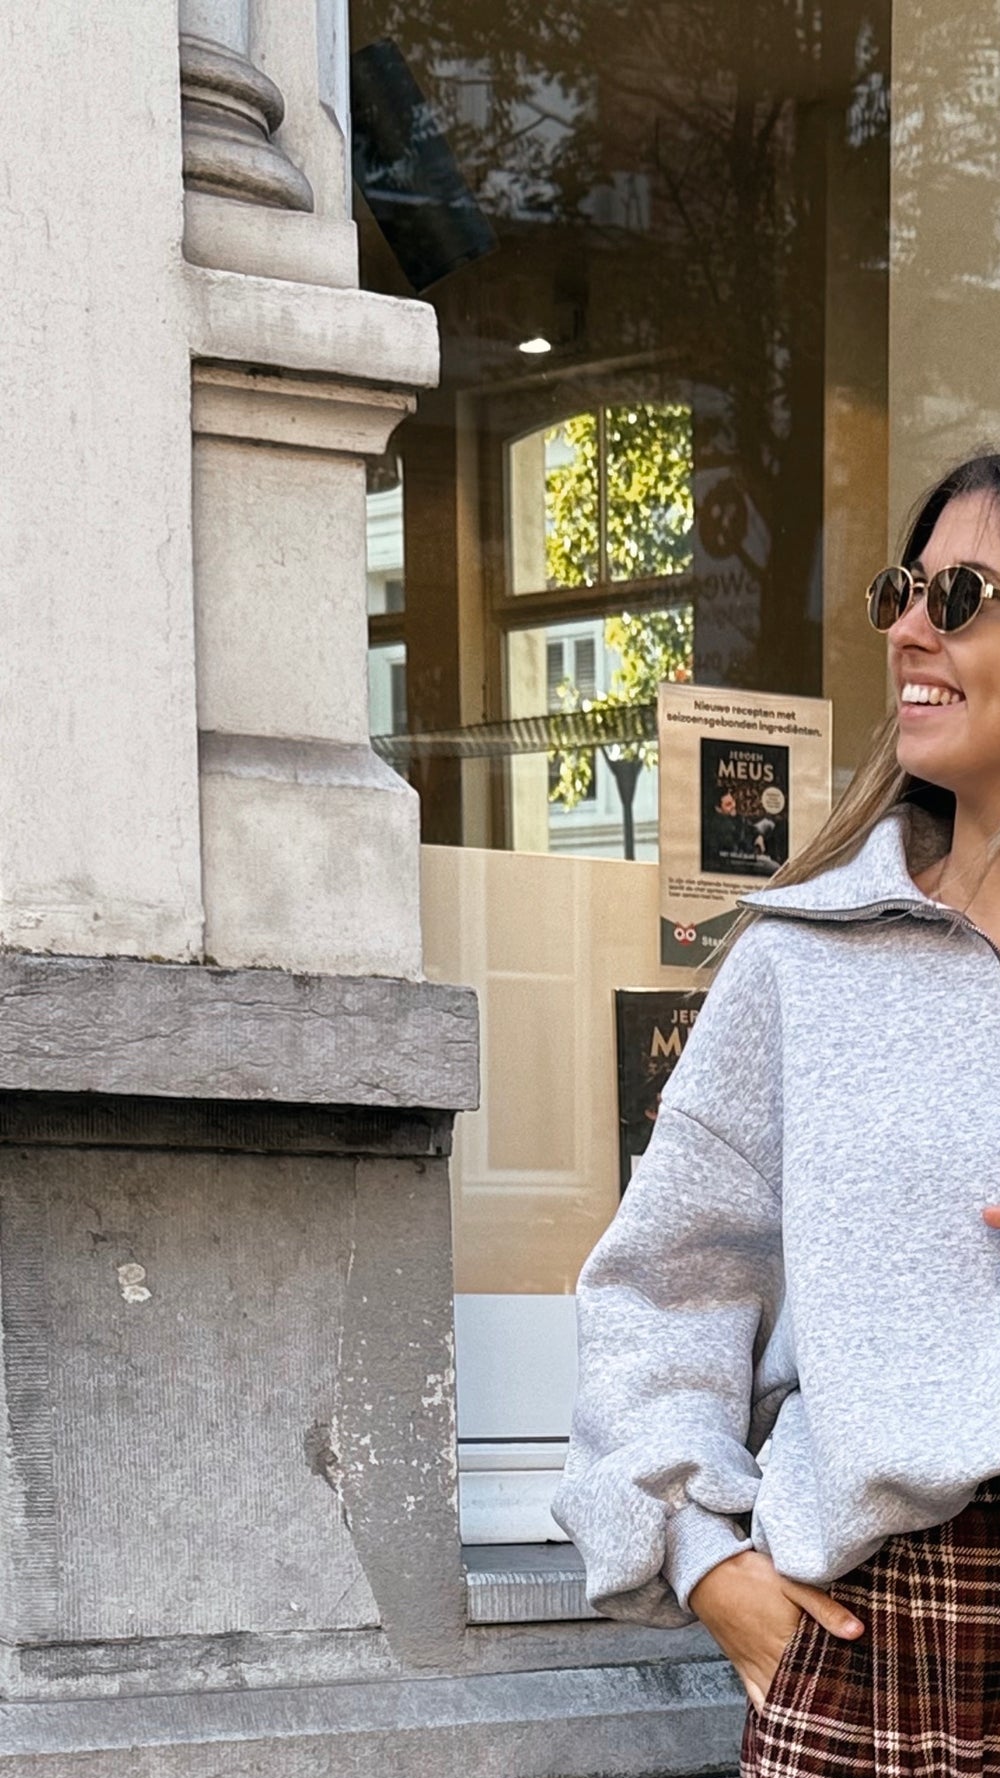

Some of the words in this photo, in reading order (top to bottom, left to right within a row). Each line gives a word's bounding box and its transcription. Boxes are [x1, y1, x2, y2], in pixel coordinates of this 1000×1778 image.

[694, 700, 730, 713] Nieuwe
[732, 706, 775, 719] recepten
[777, 710, 796, 720] met
[667, 712, 758, 729] seizoensgebonden
[729, 751, 763, 762] JEROEN
[718, 759, 774, 782] MEUS
[670, 1009, 699, 1024] JER
